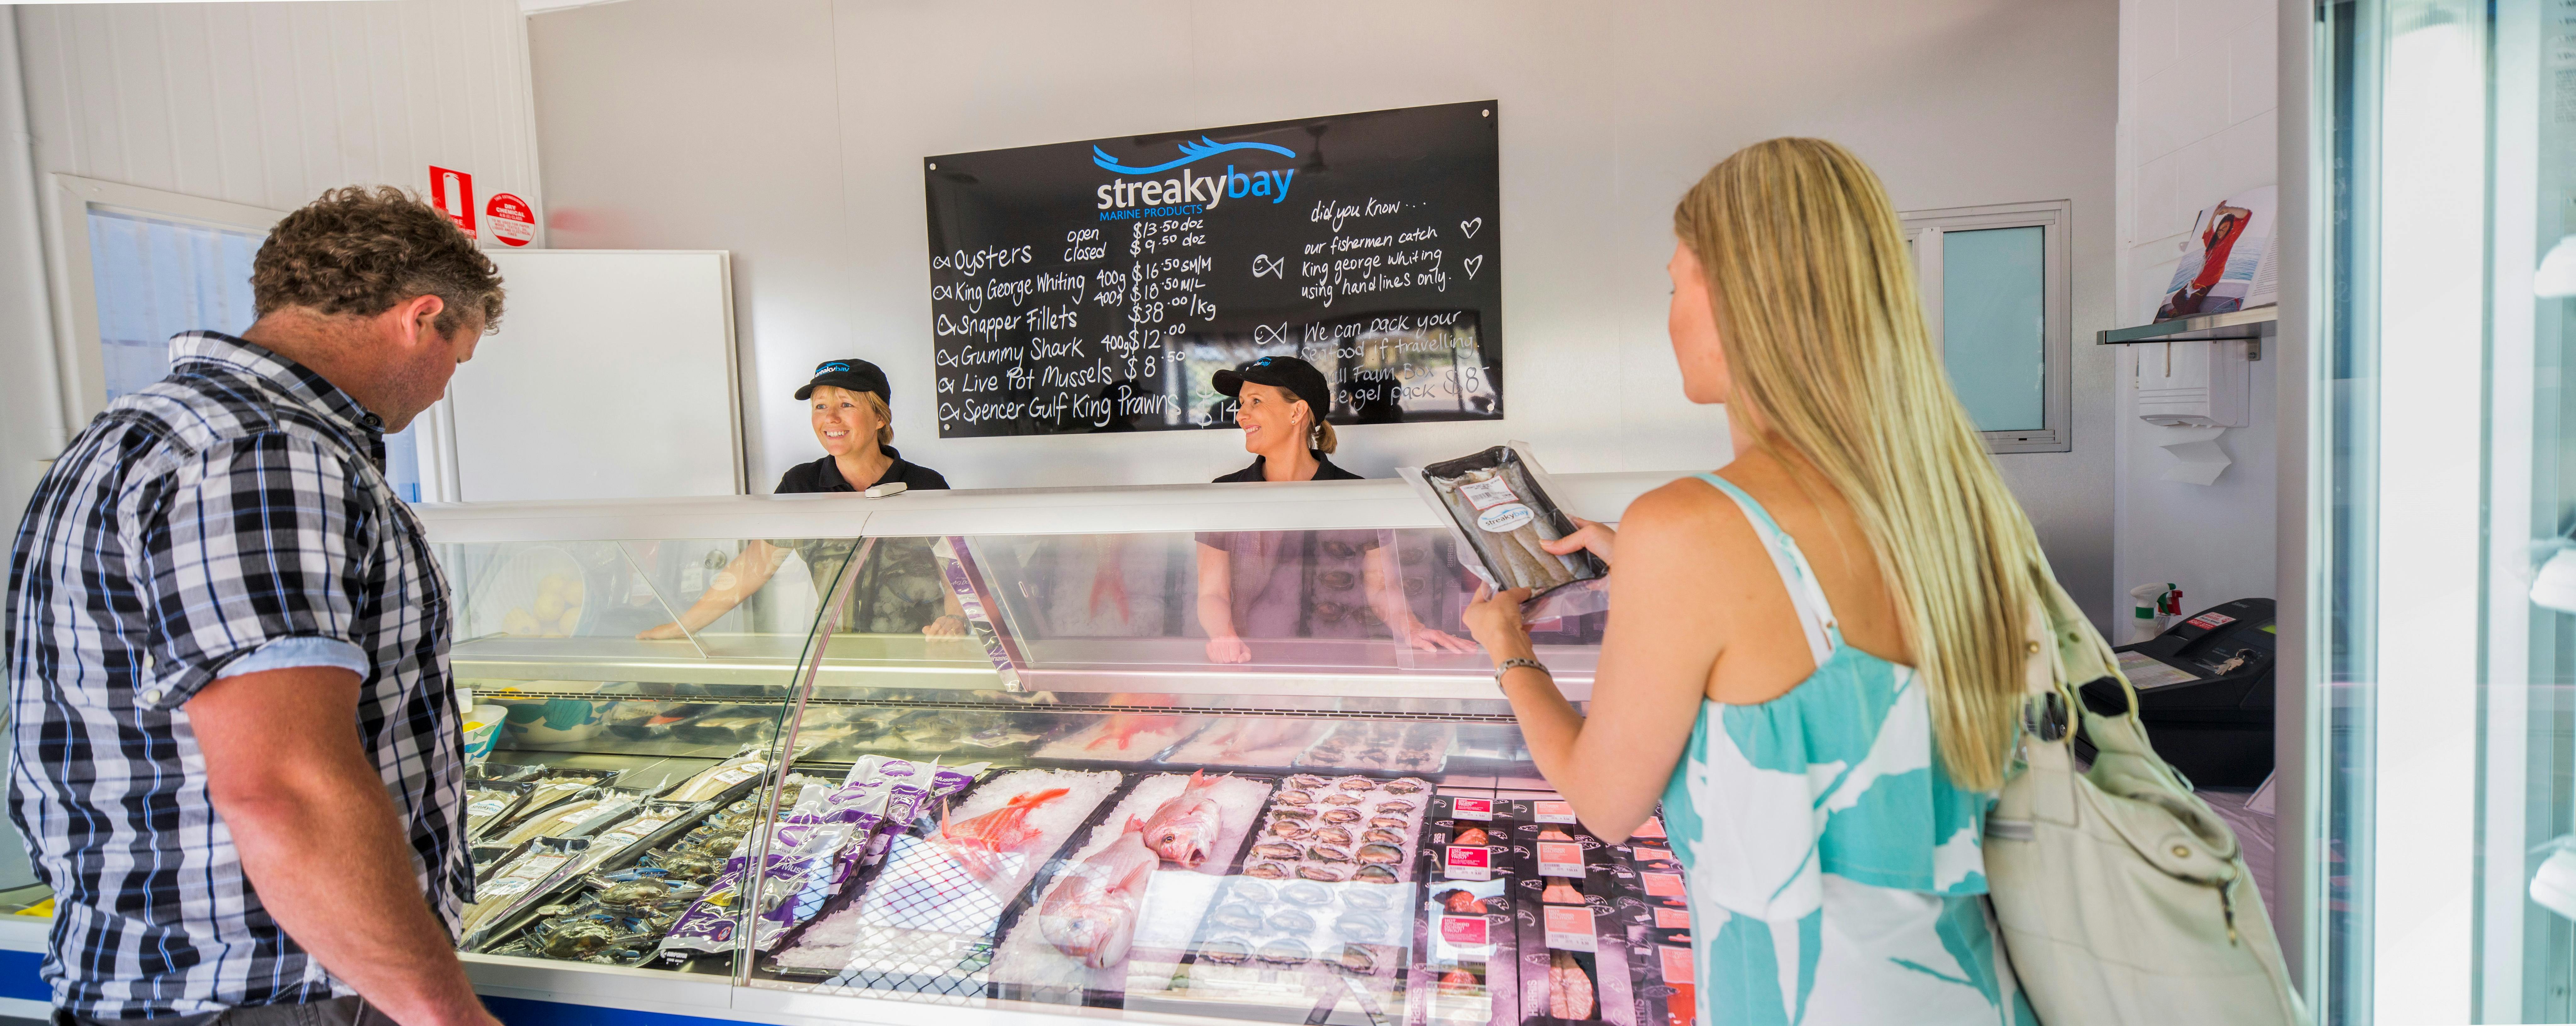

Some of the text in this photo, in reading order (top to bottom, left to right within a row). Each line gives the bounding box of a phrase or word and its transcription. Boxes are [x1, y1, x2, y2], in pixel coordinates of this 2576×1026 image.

[1097, 164, 1294, 210] streakybay
[496, 207, 525, 218] CHEMICAL
[1100, 204, 1202, 221] MARINE PRODUCTS
[1311, 200, 1336, 223] did
[1333, 206, 1360, 232] you
[1068, 229, 1099, 246] open
[1180, 217, 1203, 231] doz
[1305, 226, 1437, 254] our fishermen catch
[955, 245, 1031, 276] Oysters
[1182, 232, 1206, 246] doz
[956, 282, 982, 313] King
[987, 279, 1033, 306] George
[1037, 272, 1085, 304] Whiting
[1097, 269, 1126, 293] 400g
[1094, 291, 1123, 306] 400g
[1302, 283, 1332, 307] using
[1027, 304, 1077, 331] Fillets
[1305, 311, 1461, 342] We can pack your
[962, 345, 1023, 368] Gummy
[1031, 337, 1084, 360] Shark
[1101, 335, 1129, 358] 400g
[1374, 338, 1388, 360] if
[963, 374, 998, 392] Live
[1007, 366, 1035, 390] Pot
[1042, 358, 1112, 387] Mussels
[1352, 365, 1395, 383] Foam
[1403, 363, 1434, 380] Box
[963, 399, 1024, 425] Spencer
[1029, 392, 1068, 425] Gulf
[1073, 394, 1110, 427] King
[1118, 385, 1181, 417] Prawns
[1330, 384, 1435, 410] ce gel pack
[1485, 510, 1528, 526] streakybay
